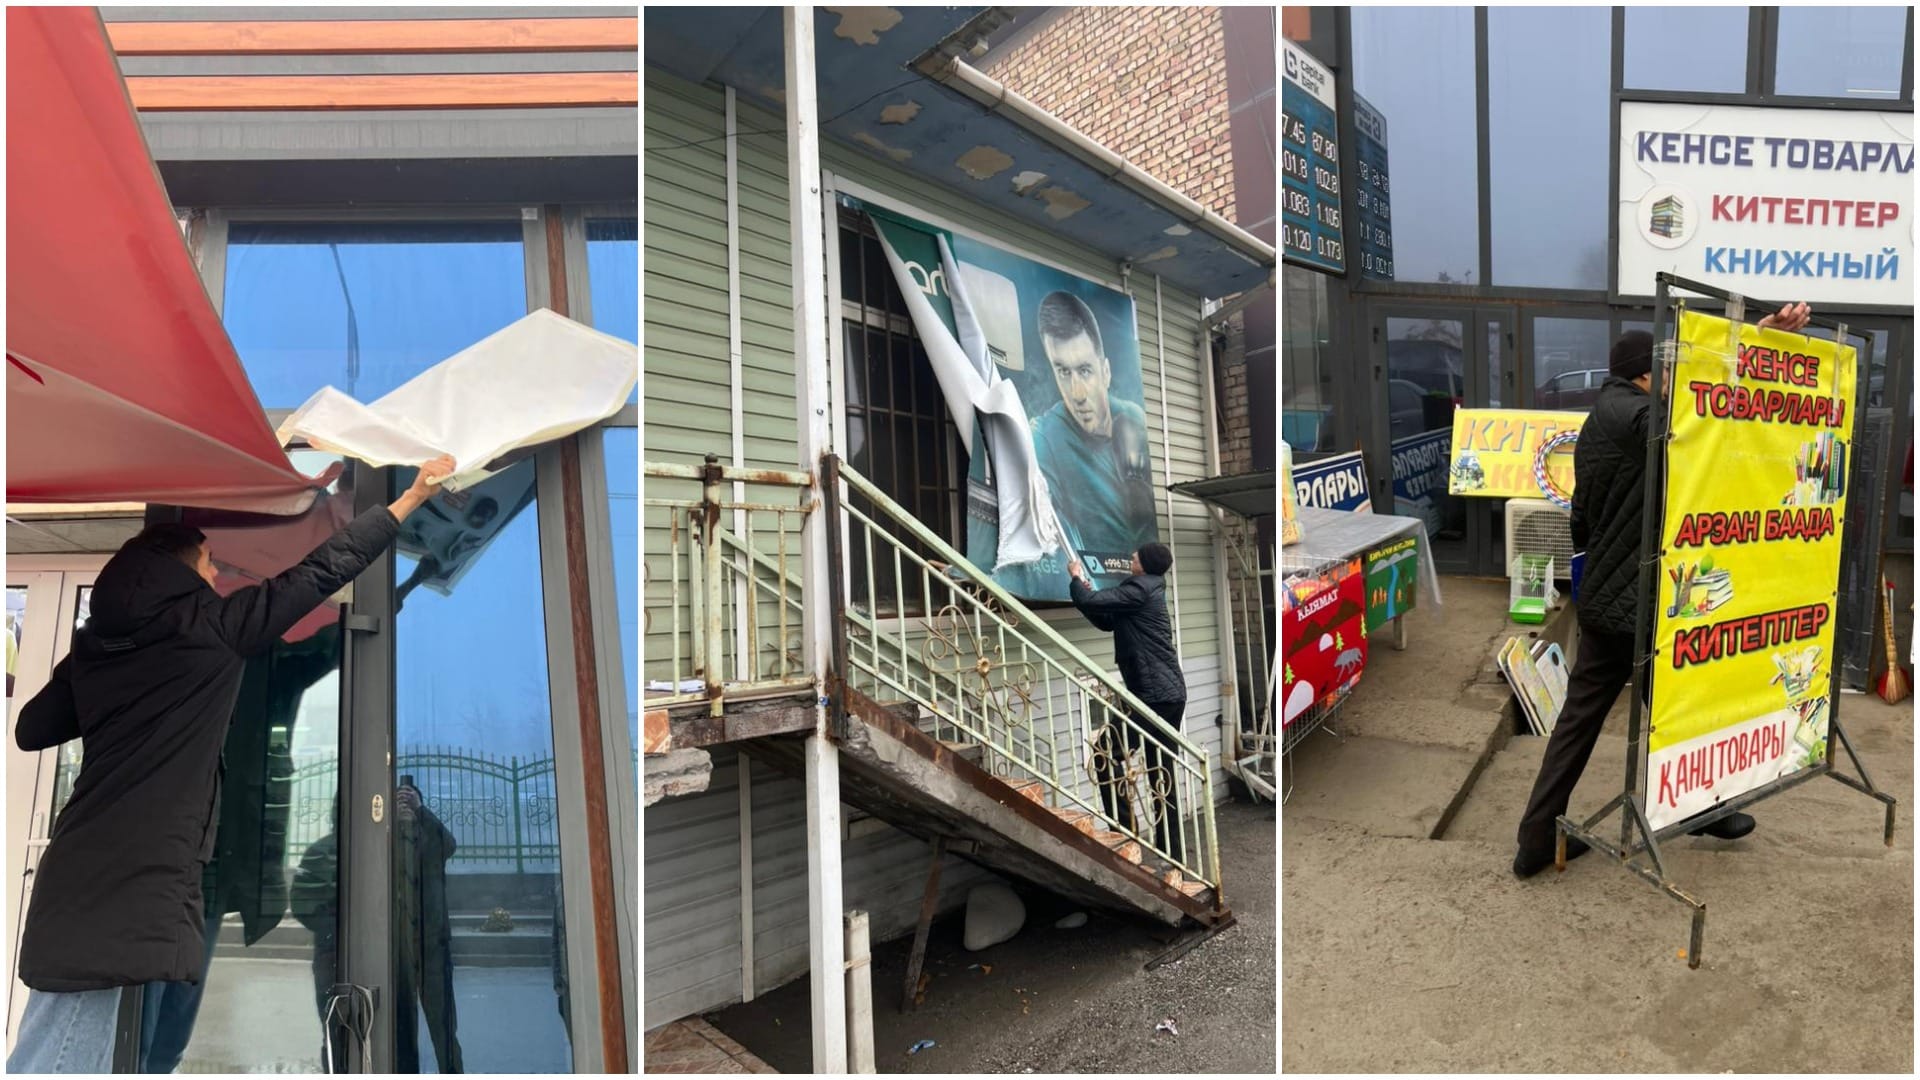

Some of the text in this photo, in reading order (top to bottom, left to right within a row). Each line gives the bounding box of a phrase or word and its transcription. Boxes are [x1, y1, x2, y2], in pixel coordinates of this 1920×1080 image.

[1300, 60, 1325, 85] capital
[1301, 72, 1320, 96] bank
[1638, 131, 1754, 167] КЕНСЕ
[1282, 150, 1338, 193] 01.8 102.8
[1712, 194, 1900, 228] КИТЕПТЕР
[1283, 224, 1342, 260] 0.120 0.173
[1705, 247, 1900, 280] КНИЖНЫЙ
[1736, 343, 1819, 388] КЕНСЕ
[1690, 381, 1845, 427] ТОВАРЛАРЫ
[1297, 466, 1364, 508] РЛАРЫ
[1674, 508, 1834, 548] АРЗАН БААДА
[1673, 603, 1829, 669] КИТЕПТЕР
[1659, 720, 1786, 808] КАНЦТОВАРЫ
